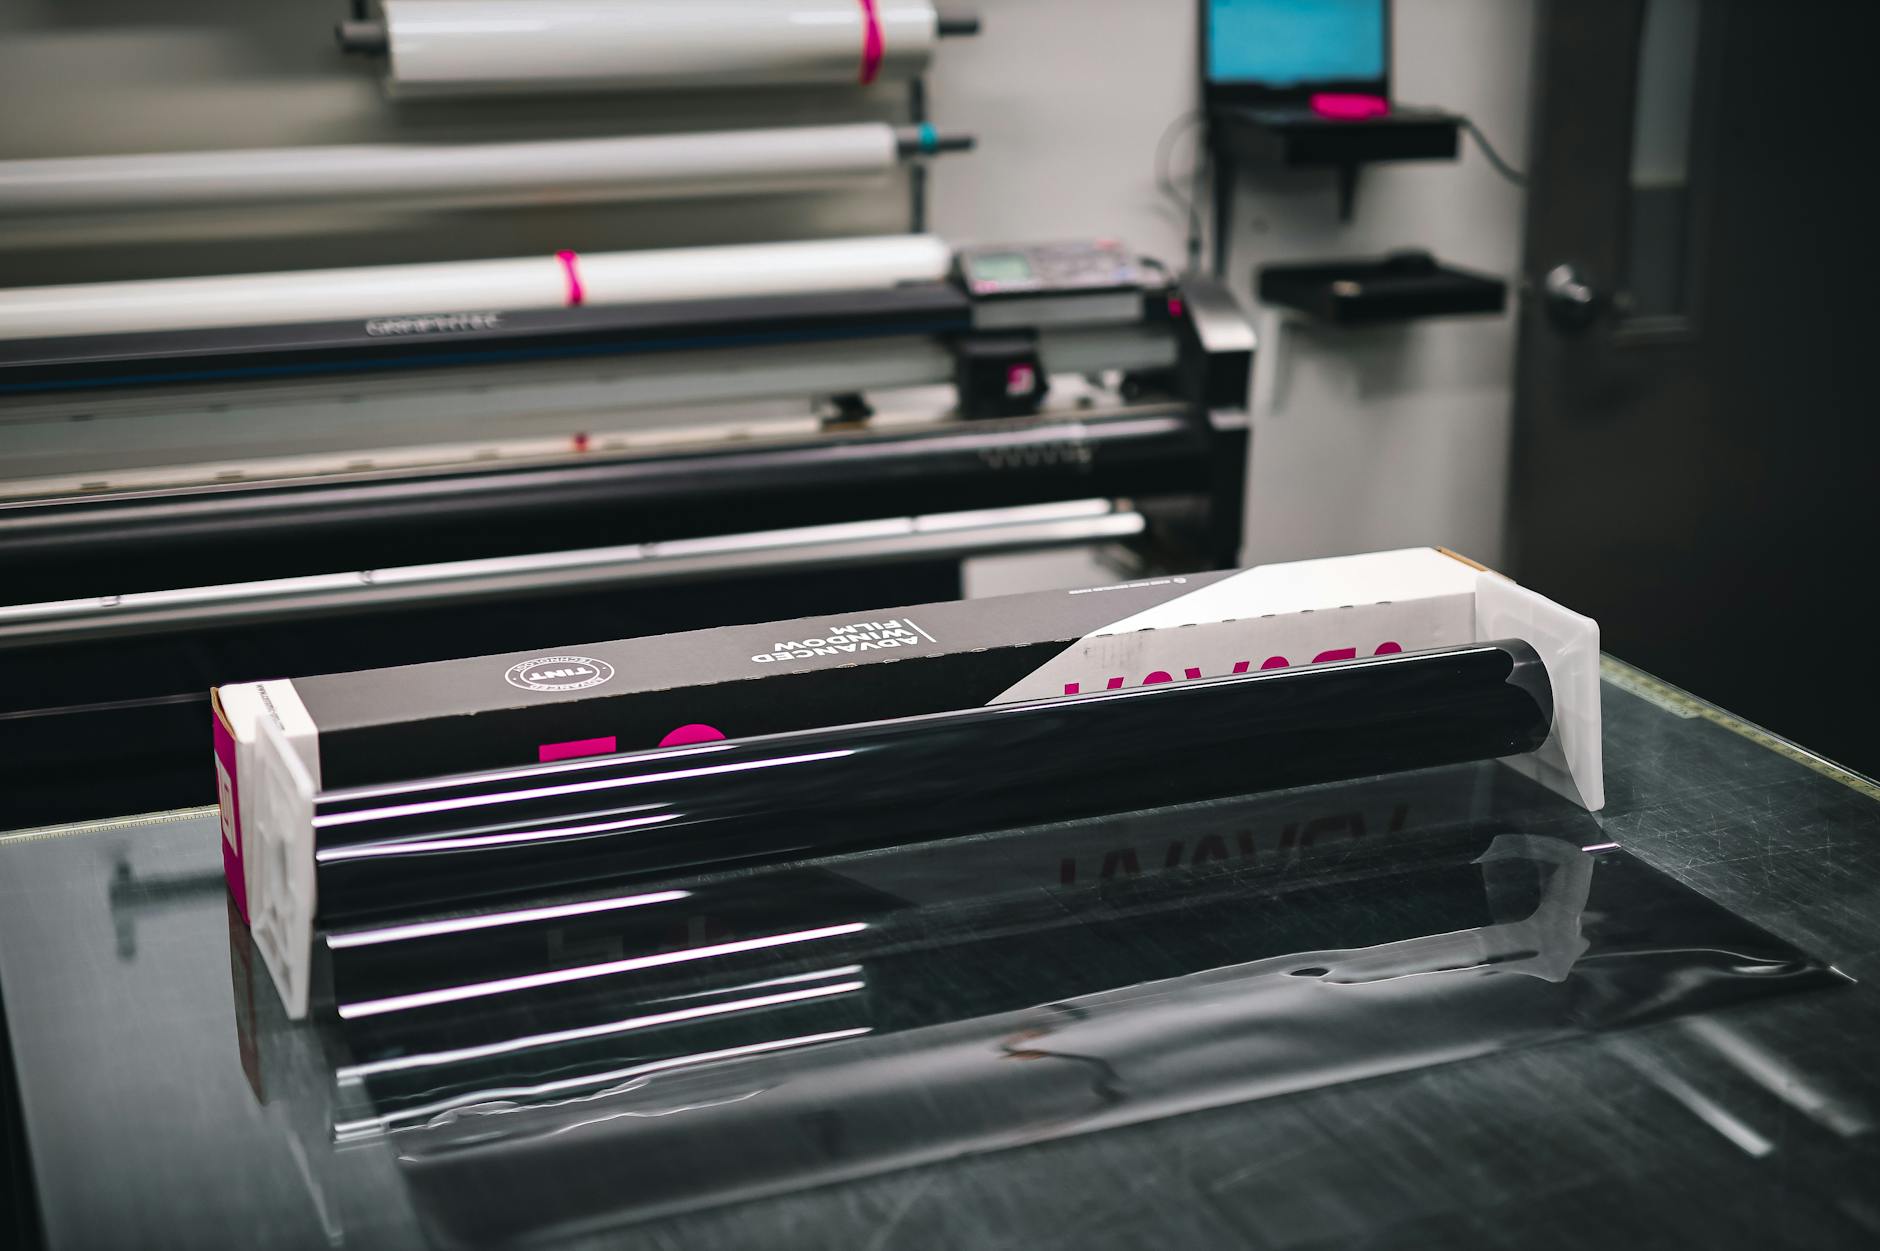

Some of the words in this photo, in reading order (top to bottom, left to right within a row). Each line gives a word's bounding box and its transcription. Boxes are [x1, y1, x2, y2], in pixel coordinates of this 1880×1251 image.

[829, 619, 903, 635] FILM
[751, 635, 919, 663] ADVANCED
[774, 628, 915, 652] WINDOW
[528, 667, 593, 681] TINT
